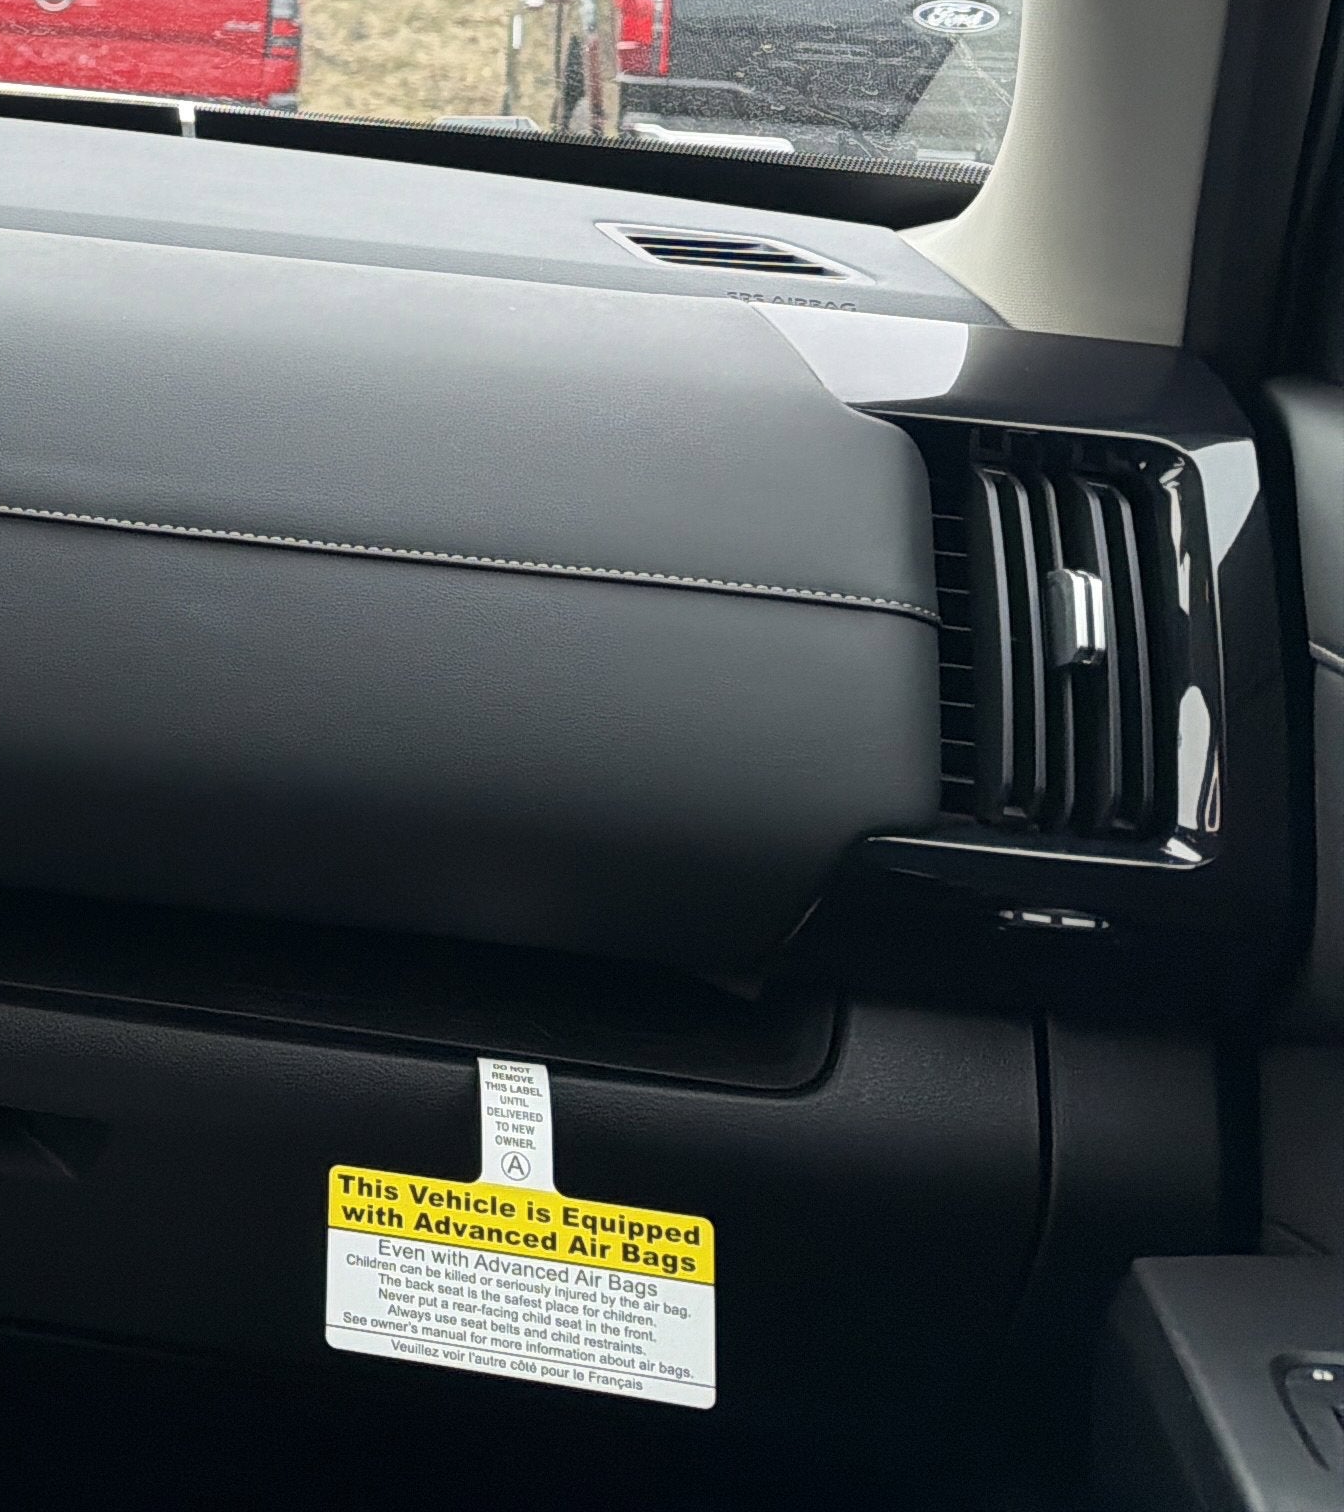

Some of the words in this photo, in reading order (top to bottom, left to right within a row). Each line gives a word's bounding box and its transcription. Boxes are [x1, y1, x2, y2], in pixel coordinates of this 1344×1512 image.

[485, 1081, 507, 1092] THIS
[510, 1085, 542, 1097] LABEL
[492, 1072, 534, 1084] REMOVE
[510, 1066, 530, 1074] NOT
[487, 1106, 543, 1122] DELIVERED
[500, 1095, 528, 1108] UNTIL
[495, 1135, 536, 1150] OWNER.
[496, 1121, 509, 1132] TO
[512, 1123, 534, 1135] NEW
[338, 1174, 397, 1200] This
[409, 1184, 515, 1217] Vehicle
[527, 1202, 550, 1222] is
[562, 1206, 699, 1245] Equipped
[342, 1205, 402, 1227] with
[414, 1212, 556, 1250] Advanced
[568, 1235, 610, 1258] Air
[622, 1242, 695, 1274] Bags
[346, 1253, 396, 1271] Children
[399, 1264, 422, 1275] can
[425, 1265, 441, 1278] be
[444, 1268, 476, 1284] killed
[479, 1276, 493, 1286] or
[495, 1278, 551, 1297] seriously
[554, 1285, 596, 1302] injured
[600, 1292, 616, 1307] by
[619, 1295, 640, 1309] the
[642, 1296, 660, 1312] air
[663, 1302, 690, 1319] bag.
[378, 1238, 424, 1261] Even
[431, 1249, 468, 1268] with
[473, 1253, 568, 1283] Advanced
[574, 1269, 602, 1288] Air
[608, 1273, 657, 1299] Bags
[377, 1272, 401, 1287] The
[405, 1277, 434, 1292] back
[437, 1284, 464, 1297] seat
[467, 1286, 477, 1299] is
[480, 1289, 500, 1302] the
[504, 1294, 541, 1309] safest
[545, 1299, 578, 1314] place
[582, 1304, 599, 1317] for
[602, 1309, 656, 1327] children.
[378, 1287, 415, 1303] Never
[418, 1296, 437, 1307] put
[440, 1299, 448, 1309] a
[452, 1301, 518, 1322] rear-facing
[521, 1310, 551, 1325] child
[554, 1317, 581, 1330] seat
[585, 1319, 596, 1332] in
[600, 1322, 620, 1336] the
[624, 1325, 656, 1342] front.
[342, 1311, 367, 1326] See
[421, 1326, 466, 1341] manual
[470, 1331, 486, 1344] for
[490, 1337, 522, 1350] more
[525, 1340, 595, 1361] information
[599, 1353, 635, 1368] about
[638, 1359, 655, 1371] air
[658, 1361, 693, 1379] bags.
[387, 1303, 431, 1322] Always
[434, 1313, 457, 1325] use
[460, 1317, 487, 1330] seat
[523, 1327, 547, 1339] and
[550, 1330, 580, 1344] child
[583, 1337, 645, 1355] restraints.
[390, 1338, 439, 1357] Veuillez
[442, 1349, 465, 1361] voir
[510, 1359, 537, 1373] côté
[540, 1365, 569, 1378] pour
[573, 1368, 584, 1381] le
[588, 1370, 642, 1390] Français
